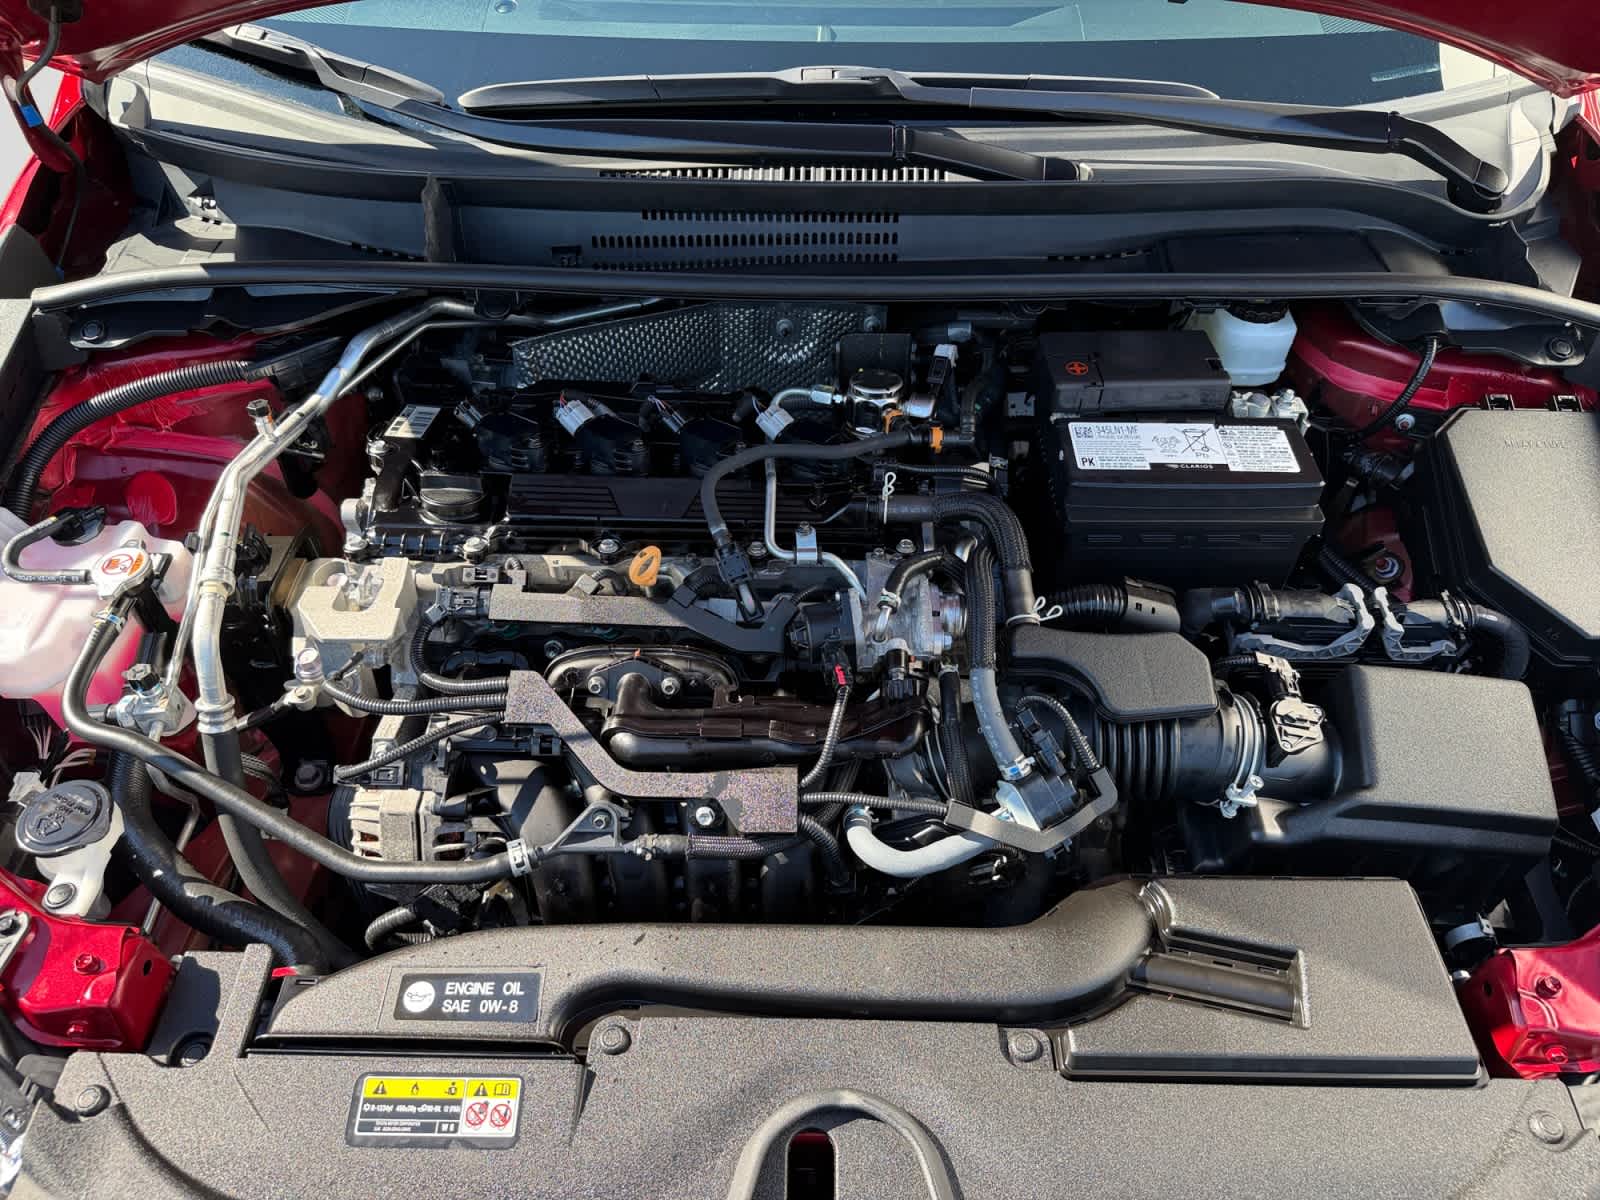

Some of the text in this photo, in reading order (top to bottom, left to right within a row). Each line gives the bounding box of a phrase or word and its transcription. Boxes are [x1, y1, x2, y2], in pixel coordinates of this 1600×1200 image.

[1081, 457, 1095, 467] PK
[444, 982, 525, 995] ENGINE OIL
[441, 999, 519, 1013] SAE 0W-8
